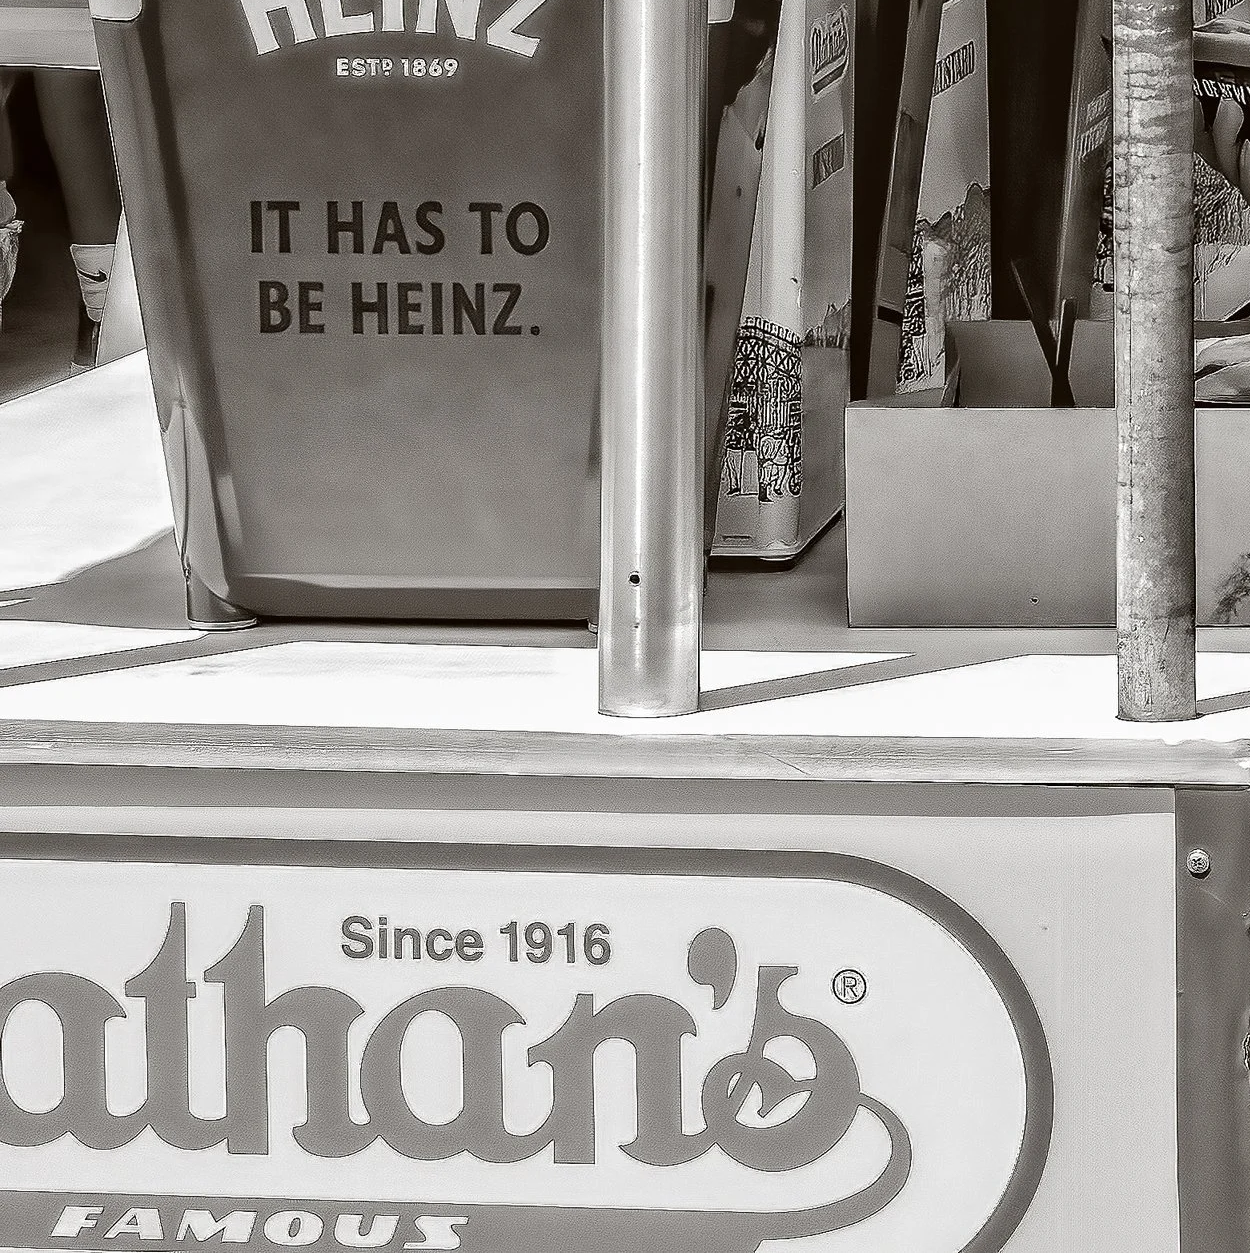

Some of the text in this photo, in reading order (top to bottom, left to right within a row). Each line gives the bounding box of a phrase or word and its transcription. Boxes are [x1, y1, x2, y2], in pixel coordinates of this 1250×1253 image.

[401, 58, 459, 78] 1869
[250, 200, 550, 256] IT HAS TO
[258, 280, 541, 336] BE HEINZ.
[340, 914, 612, 966] Since 1916
[0, 901, 861, 1173] athan's
[50, 1205, 469, 1251] FAMOUS
